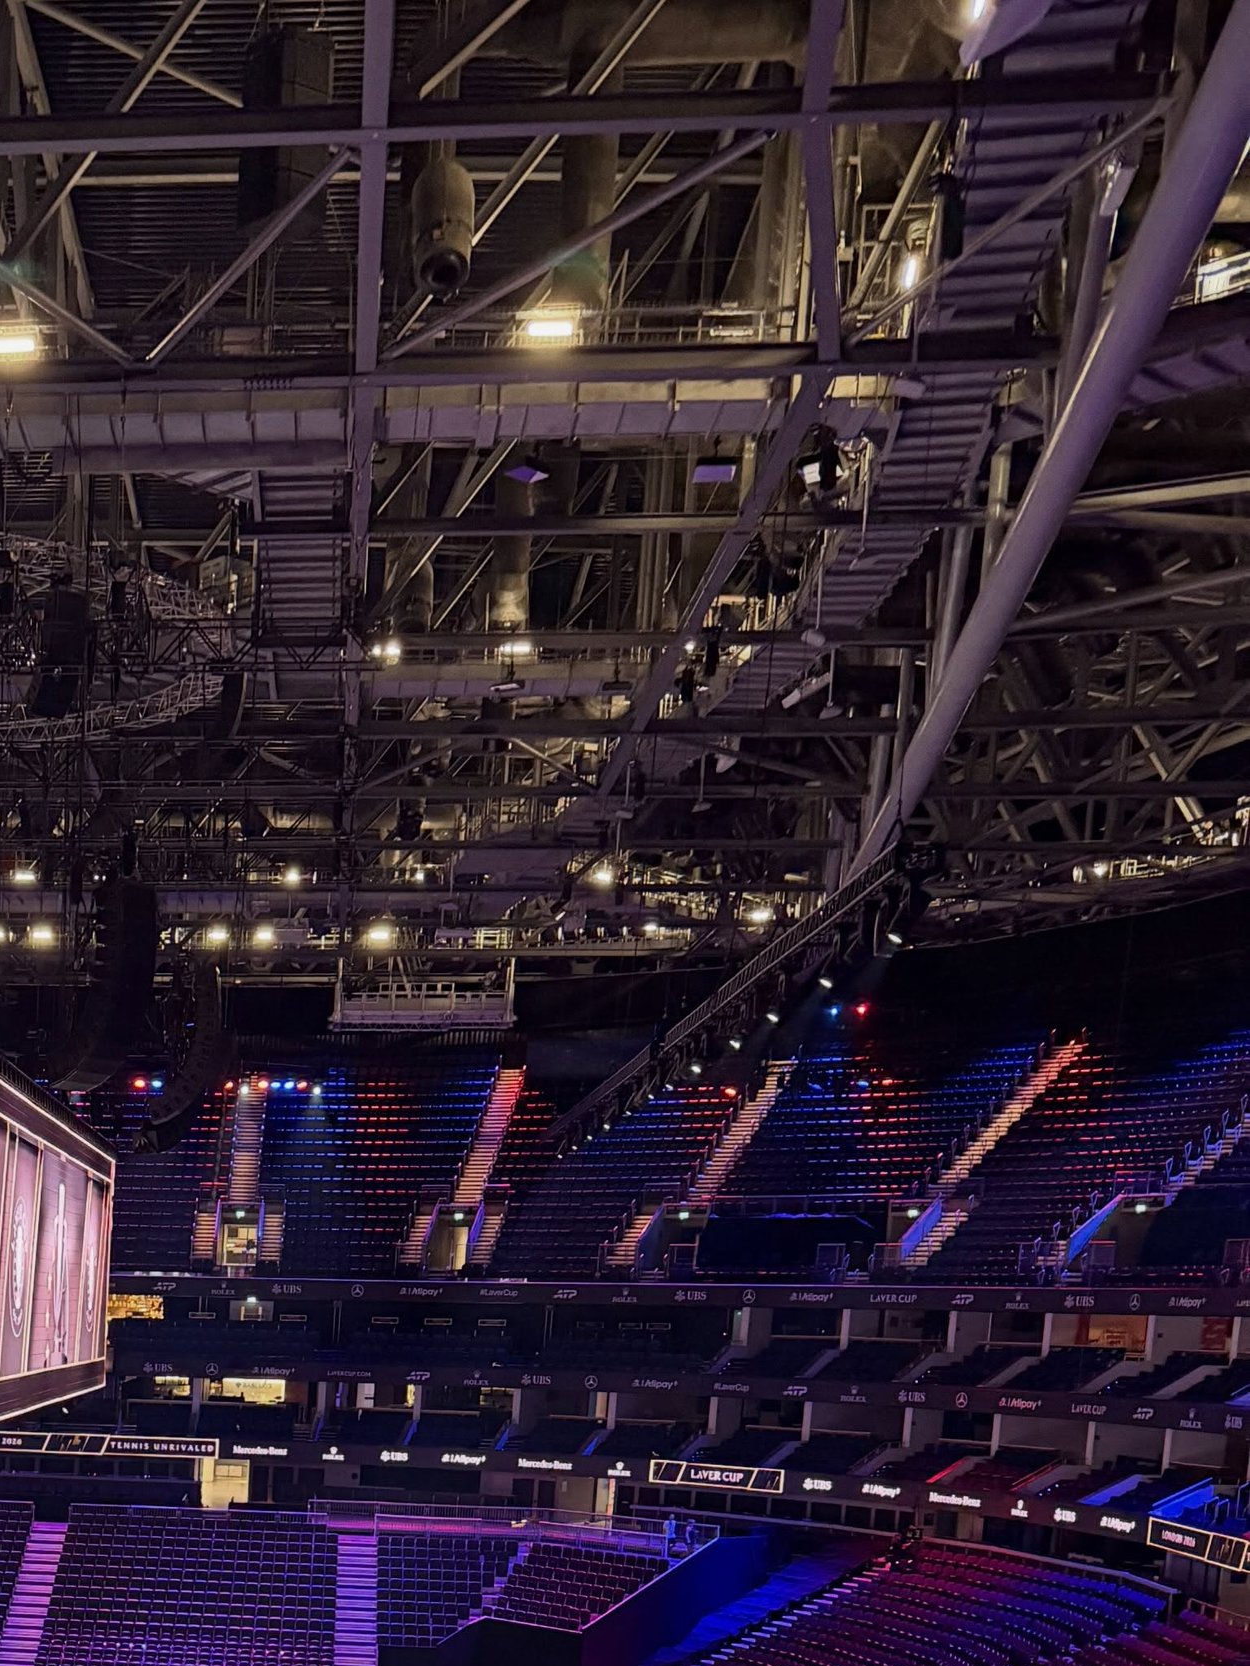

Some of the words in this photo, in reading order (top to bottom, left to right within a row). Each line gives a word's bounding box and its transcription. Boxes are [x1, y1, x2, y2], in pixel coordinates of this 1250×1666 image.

[282, 1284, 302, 1295] UBS
[479, 1287, 518, 1298] #LaverCup
[611, 1296, 637, 1304] ROLEX
[687, 1290, 707, 1301] UBS
[869, 1293, 898, 1304] LAVER
[899, 1294, 917, 1304] CUP
[1005, 1301, 1030, 1310] ROLEX
[1075, 1295, 1095, 1308] UBS
[154, 1363, 174, 1374] UBS
[463, 1379, 489, 1387] ROLEX
[532, 1375, 552, 1386] UBS
[839, 1395, 866, 1404] ROLEX
[907, 1392, 926, 1404] UBS
[1092, 1404, 1108, 1416] CUP
[1179, 1419, 1203, 1430] ROLEX
[1, 1436, 23, 1446] 2026
[110, 1440, 150, 1451] TENNIS
[153, 1441, 214, 1454] UNRIVALED
[232, 1444, 288, 1457] Mercedes-Benz
[517, 1458, 573, 1472] Mercedes-Benz
[690, 1469, 723, 1483] LAVER
[724, 1473, 744, 1484] CUP
[813, 1481, 832, 1492] UBS
[929, 1491, 982, 1509] Mercedes-Benz
